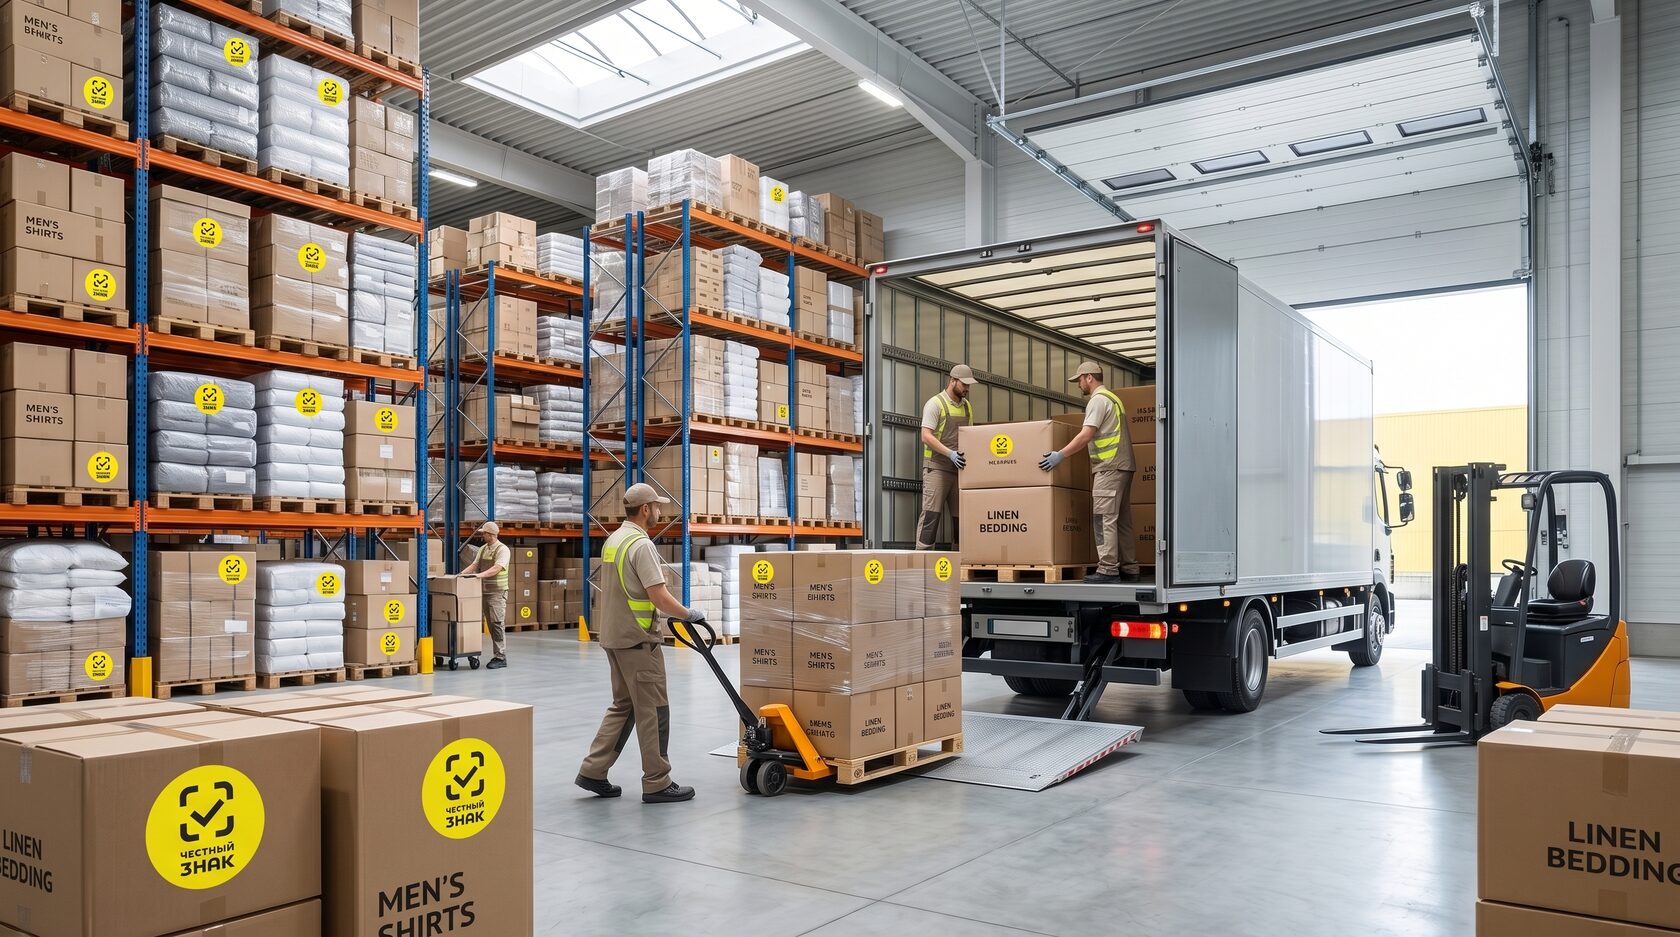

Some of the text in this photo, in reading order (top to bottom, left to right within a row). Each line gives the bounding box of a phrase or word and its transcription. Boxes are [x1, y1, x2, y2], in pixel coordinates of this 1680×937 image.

[24, 15, 58, 33] MEN'S
[25, 215, 59, 229] MEN'S
[25, 225, 64, 241] SHIRTS
[26, 404, 59, 414] MEN'S
[25, 414, 64, 425] SHIRTS
[987, 510, 1019, 520] LINEN
[979, 523, 1028, 533] BEDDING
[809, 583, 833, 592] MEN'S
[753, 648, 776, 657] MEN'S
[752, 657, 778, 666] SHIRTS
[807, 661, 835, 670] SHIRTS
[936, 702, 952, 712] LINEN
[861, 726, 886, 737] BEDDING
[445, 798, 485, 815] ЧЕСТНЫЙ
[445, 810, 485, 829] ЗНАК
[1568, 821, 1661, 853] LINEN
[3, 829, 42, 860] LINEN
[180, 841, 236, 859] ЧЕСТНЫЙ
[179, 858, 235, 877] ЗНАК
[1547, 846, 1680, 886] BEDDING
[378, 871, 465, 918] MEN'S
